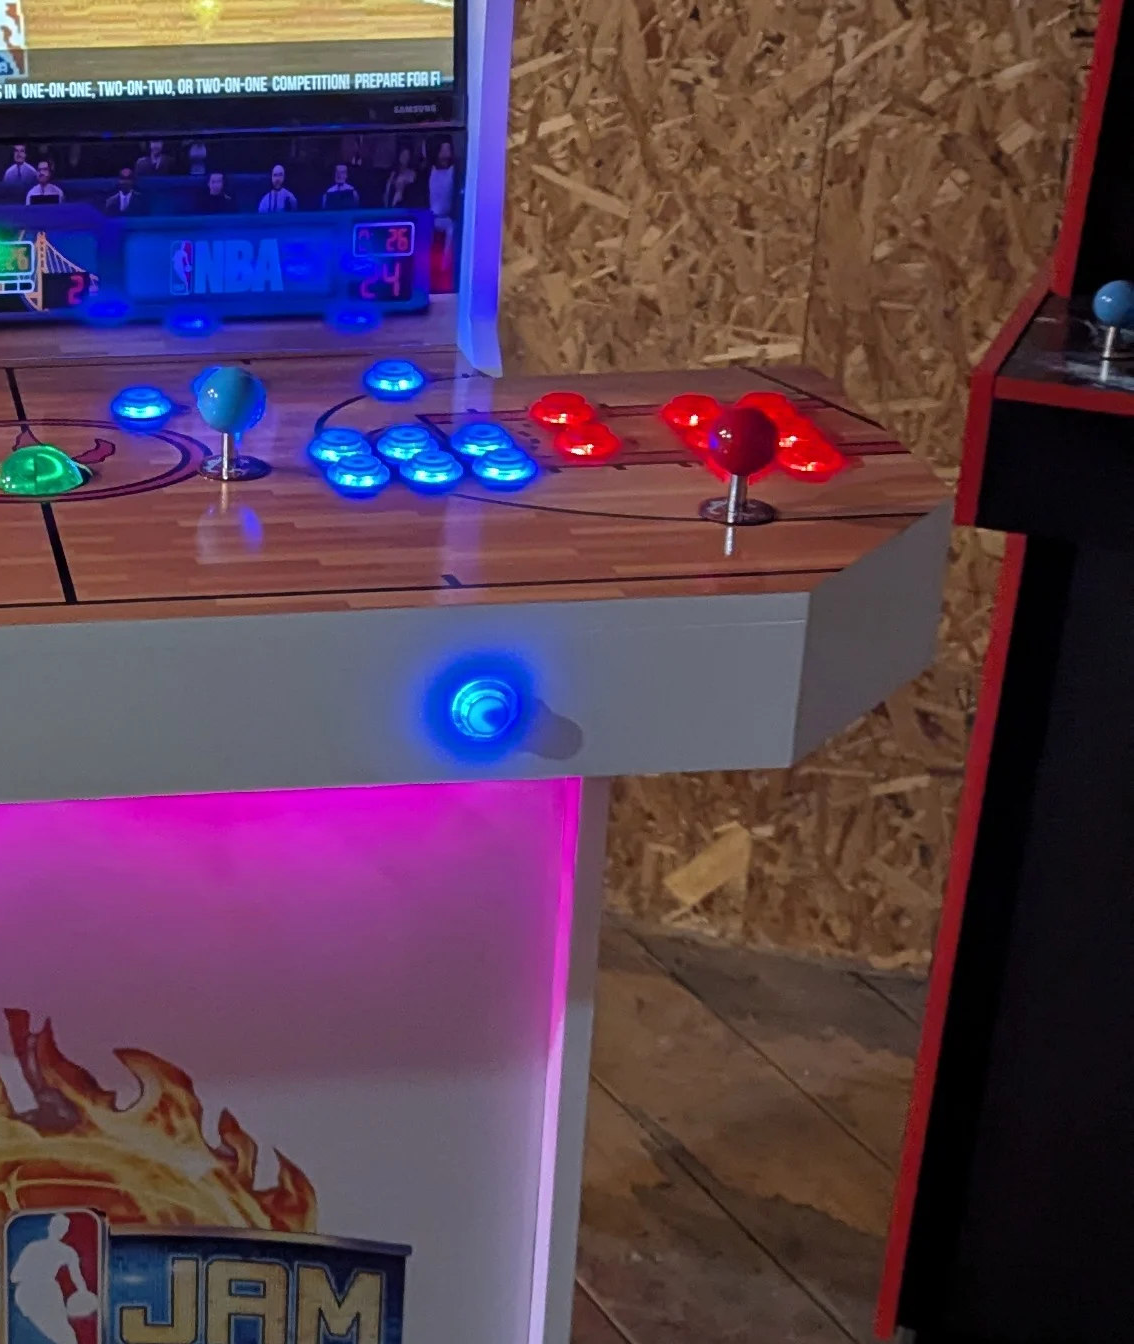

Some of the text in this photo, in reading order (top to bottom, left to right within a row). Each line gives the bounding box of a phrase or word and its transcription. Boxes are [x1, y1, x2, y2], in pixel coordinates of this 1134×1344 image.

[4, 83, 17, 100] IN
[21, 82, 97, 100] ONE-ON-ONE,
[98, 80, 176, 98] TWO-ON-TWO,
[177, 79, 194, 96] OR
[195, 77, 268, 95] TWO-ON-ONE
[271, 74, 350, 92] COMPETITION!
[354, 72, 405, 90] PREPARE
[407, 71, 429, 88] FOR
[193, 238, 284, 294] NBA
